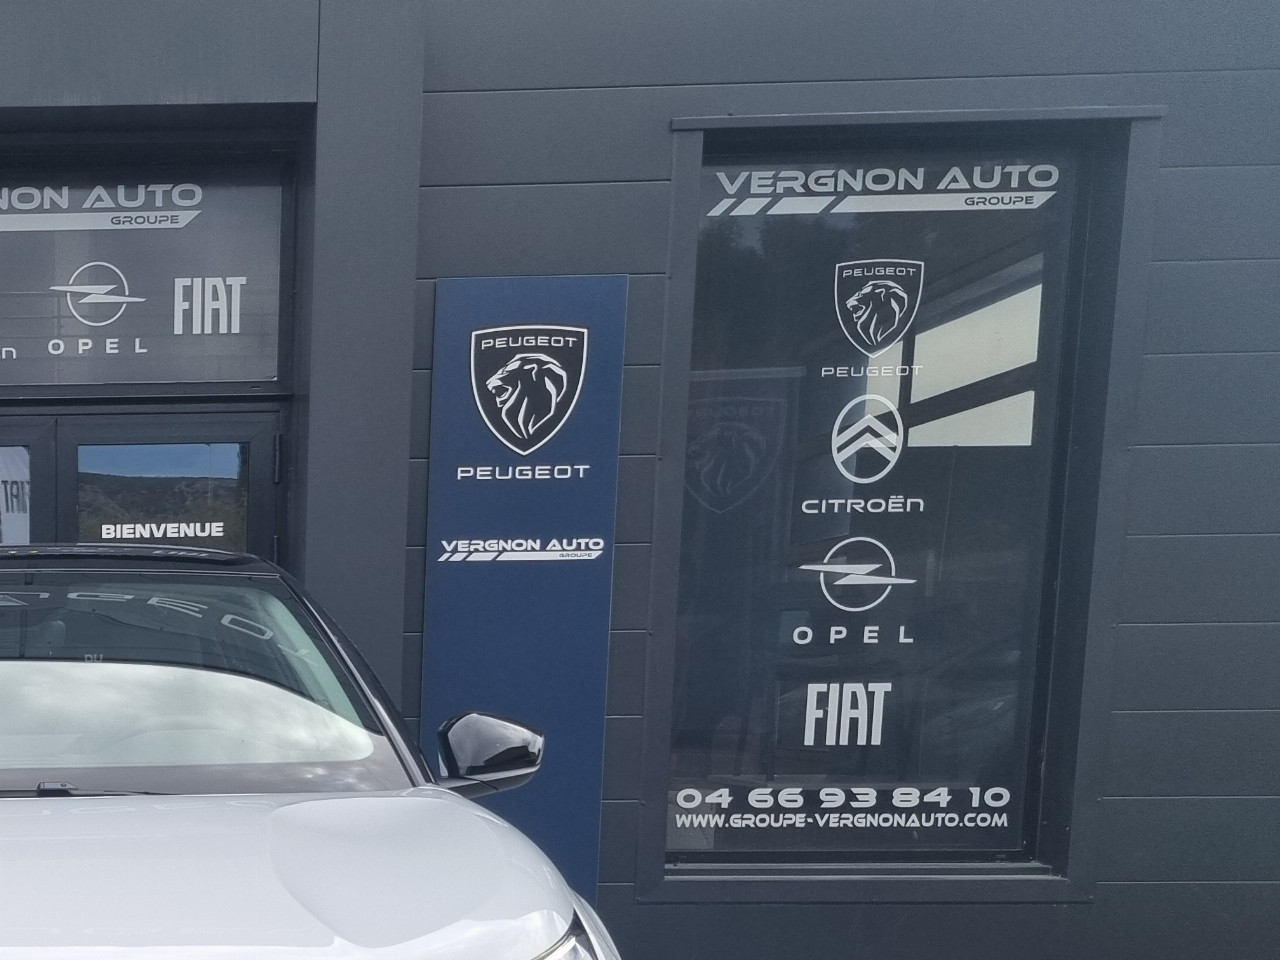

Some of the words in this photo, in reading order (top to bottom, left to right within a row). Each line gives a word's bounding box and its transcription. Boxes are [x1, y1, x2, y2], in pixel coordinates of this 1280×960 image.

[715, 167, 924, 194] VERGNON
[936, 164, 1060, 191] AUTO
[81, 183, 203, 209] AUTO
[964, 195, 1034, 206] GROUPE
[110, 214, 180, 226] GROUPE
[842, 266, 917, 278] PEUGEOT
[173, 276, 247, 335] FIAT
[47, 337, 148, 355] OPEL
[480, 335, 578, 350] PEUGEOT
[820, 365, 924, 378] PEUGEOT
[457, 465, 591, 480] PEUGEOT
[101, 521, 224, 539] BIENVENUE
[440, 538, 541, 552] VERGNON
[545, 538, 605, 550] AUTO
[792, 625, 914, 645] OPEL
[803, 682, 893, 746] FIAT
[676, 788, 734, 809] 04
[747, 787, 804, 809] 66
[819, 787, 878, 808] 93
[891, 786, 953, 808] 84
[968, 786, 1011, 808] 10
[675, 812, 1008, 829] WWW.GROUPE-VERGNONAUTO.COM
